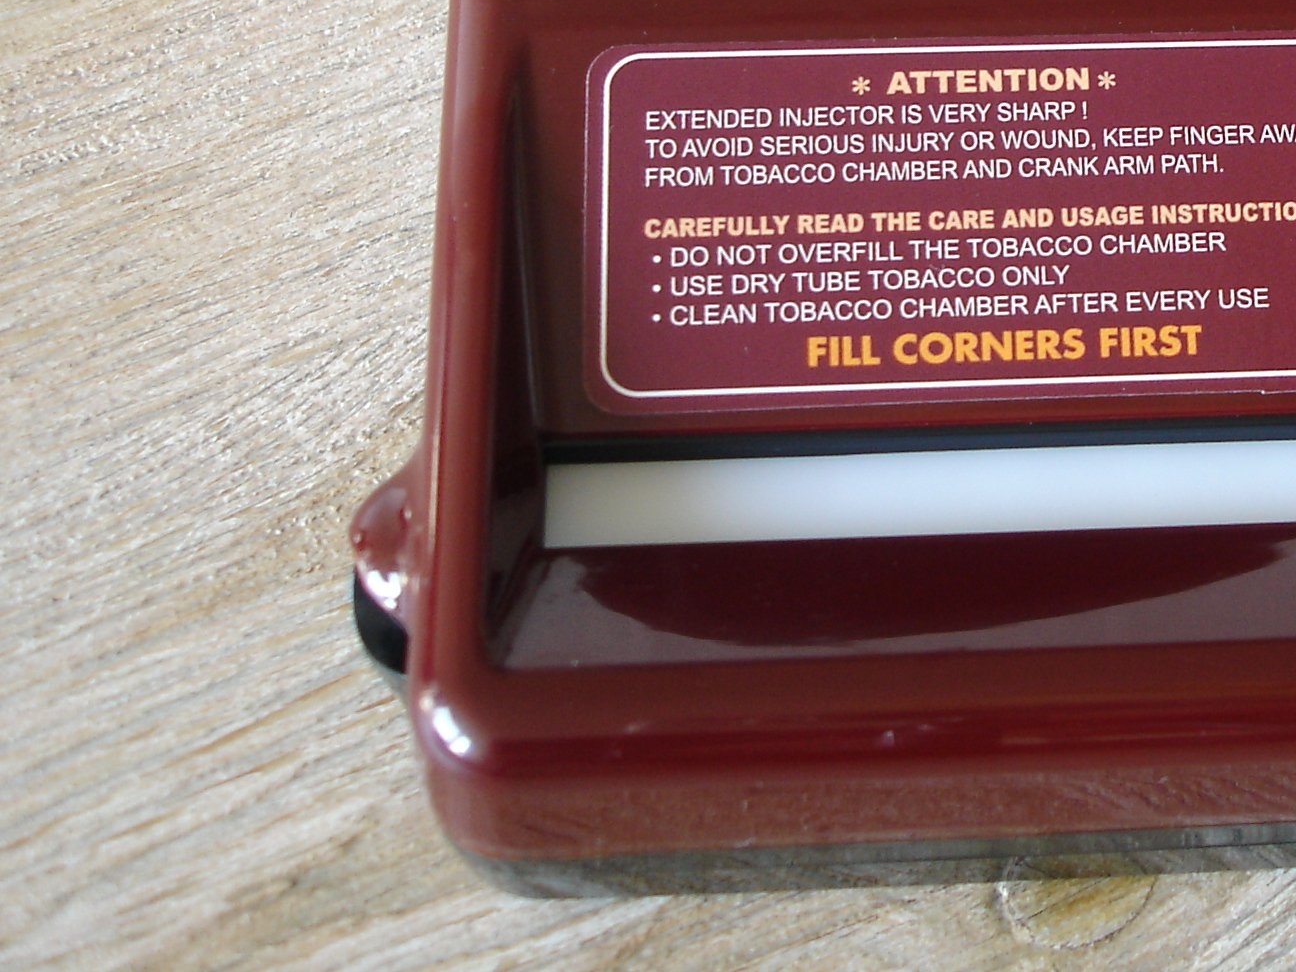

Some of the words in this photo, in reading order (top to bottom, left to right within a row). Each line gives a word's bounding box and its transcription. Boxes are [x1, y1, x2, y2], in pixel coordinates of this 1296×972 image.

[886, 67, 1090, 95] ATTENTION
[645, 107, 773, 131] EXTENDED
[779, 105, 895, 127] INJECTOR
[900, 104, 923, 125] IS
[927, 102, 992, 124] VERY
[644, 138, 678, 159] TO
[680, 136, 754, 158] AVOID
[759, 133, 865, 157] SERIOUS
[871, 131, 955, 153] INJURY
[959, 130, 996, 152] OR
[1000, 128, 1097, 151] WOUND,
[1103, 126, 1164, 148] KEEP
[1169, 124, 1256, 146] FINGER
[644, 165, 714, 188] FROM
[719, 162, 836, 186] TOBACCO
[841, 159, 959, 183] CHAMBER
[962, 158, 1012, 180] AND
[1018, 156, 1100, 178] CRANK
[1103, 154, 1155, 176] ARM
[1160, 153, 1224, 174] PATH.
[643, 214, 791, 239] CAREFULLY
[797, 212, 865, 235] READ
[870, 211, 922, 233] THE
[927, 209, 995, 231] CARE
[1001, 207, 1054, 229] AND
[1060, 205, 1145, 228] USAGE
[670, 245, 710, 268] DO
[716, 244, 773, 266] NOT
[777, 240, 904, 265] OVERFILL
[907, 238, 961, 260] THE
[965, 235, 1093, 259] TOBACCO
[1099, 231, 1227, 255] CHAMBER
[670, 274, 724, 297] USE
[731, 272, 786, 295] DRY
[790, 270, 862, 293] TUBE
[866, 266, 995, 291] TOBACCO
[1001, 264, 1070, 287] ONLY
[669, 303, 757, 327] CLEAN
[762, 298, 893, 323] TOBACCO
[899, 294, 1029, 319] CHAMBER
[1033, 292, 1119, 315] AFTER
[1125, 289, 1211, 313] EVERY
[1218, 287, 1270, 310] USE
[807, 335, 881, 368] FILL
[893, 327, 1086, 365] CORNERS
[1099, 324, 1202, 358] FIRST
